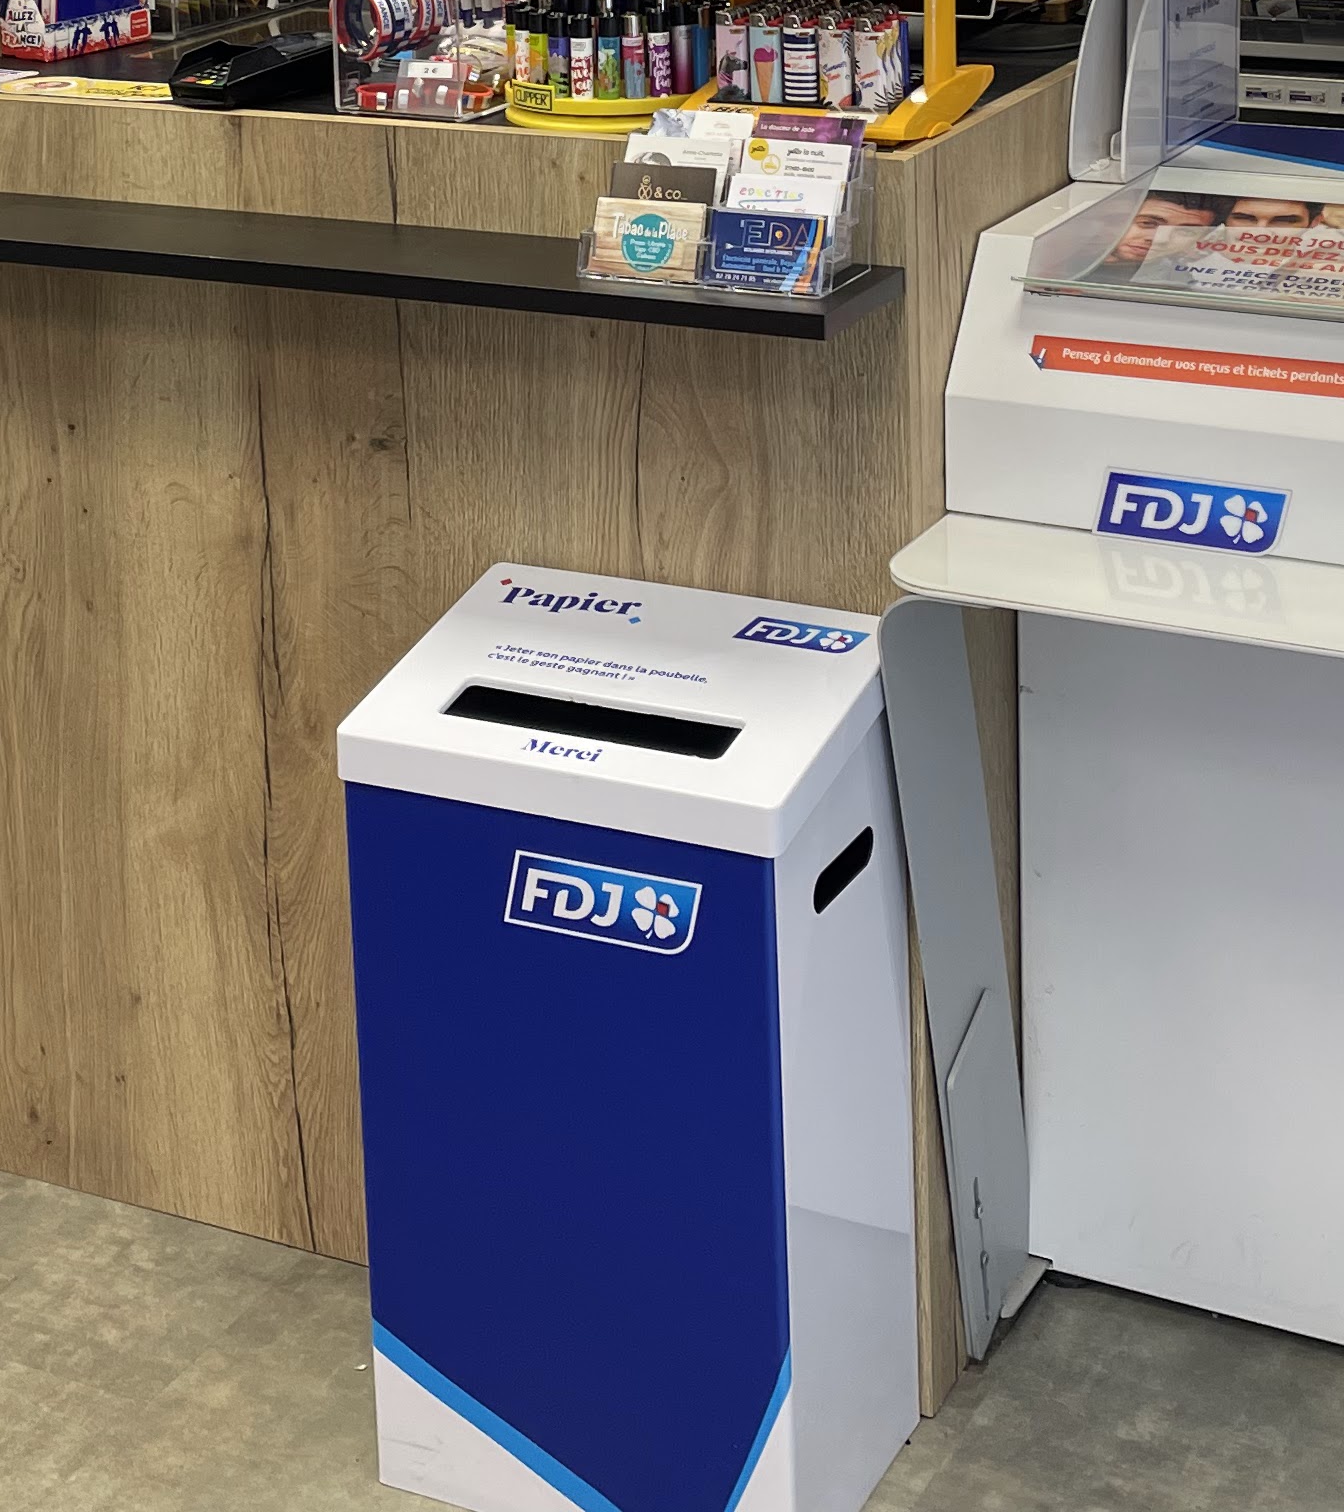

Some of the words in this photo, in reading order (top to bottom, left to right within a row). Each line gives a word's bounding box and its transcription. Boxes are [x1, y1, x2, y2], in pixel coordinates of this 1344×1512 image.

[1196, 241, 1257, 255] VOUS
[1263, 247, 1332, 263] DEVEZ
[1239, 232, 1302, 247] POUR
[1062, 347, 1101, 366] Pensez
[1103, 349, 1112, 362] à
[1114, 352, 1173, 369] demander
[1175, 360, 1196, 371] vos
[1198, 362, 1230, 377] reçus
[1232, 363, 1245, 375] et
[1248, 364, 1288, 380] tickets
[1109, 482, 1215, 536] FDJ
[498, 585, 643, 616] Papier
[744, 621, 816, 645] FDJ
[488, 652, 515, 665] c'est
[517, 656, 529, 665] le
[530, 659, 565, 673] geste
[566, 665, 620, 681] gagnant
[503, 644, 536, 658] Jeter
[536, 650, 559, 660] son
[559, 654, 601, 670] papier
[603, 660, 634, 671] dans
[636, 665, 647, 674] la
[648, 668, 708, 684] poubelle,
[520, 737, 604, 763] Merci
[520, 868, 625, 929] FDJ
